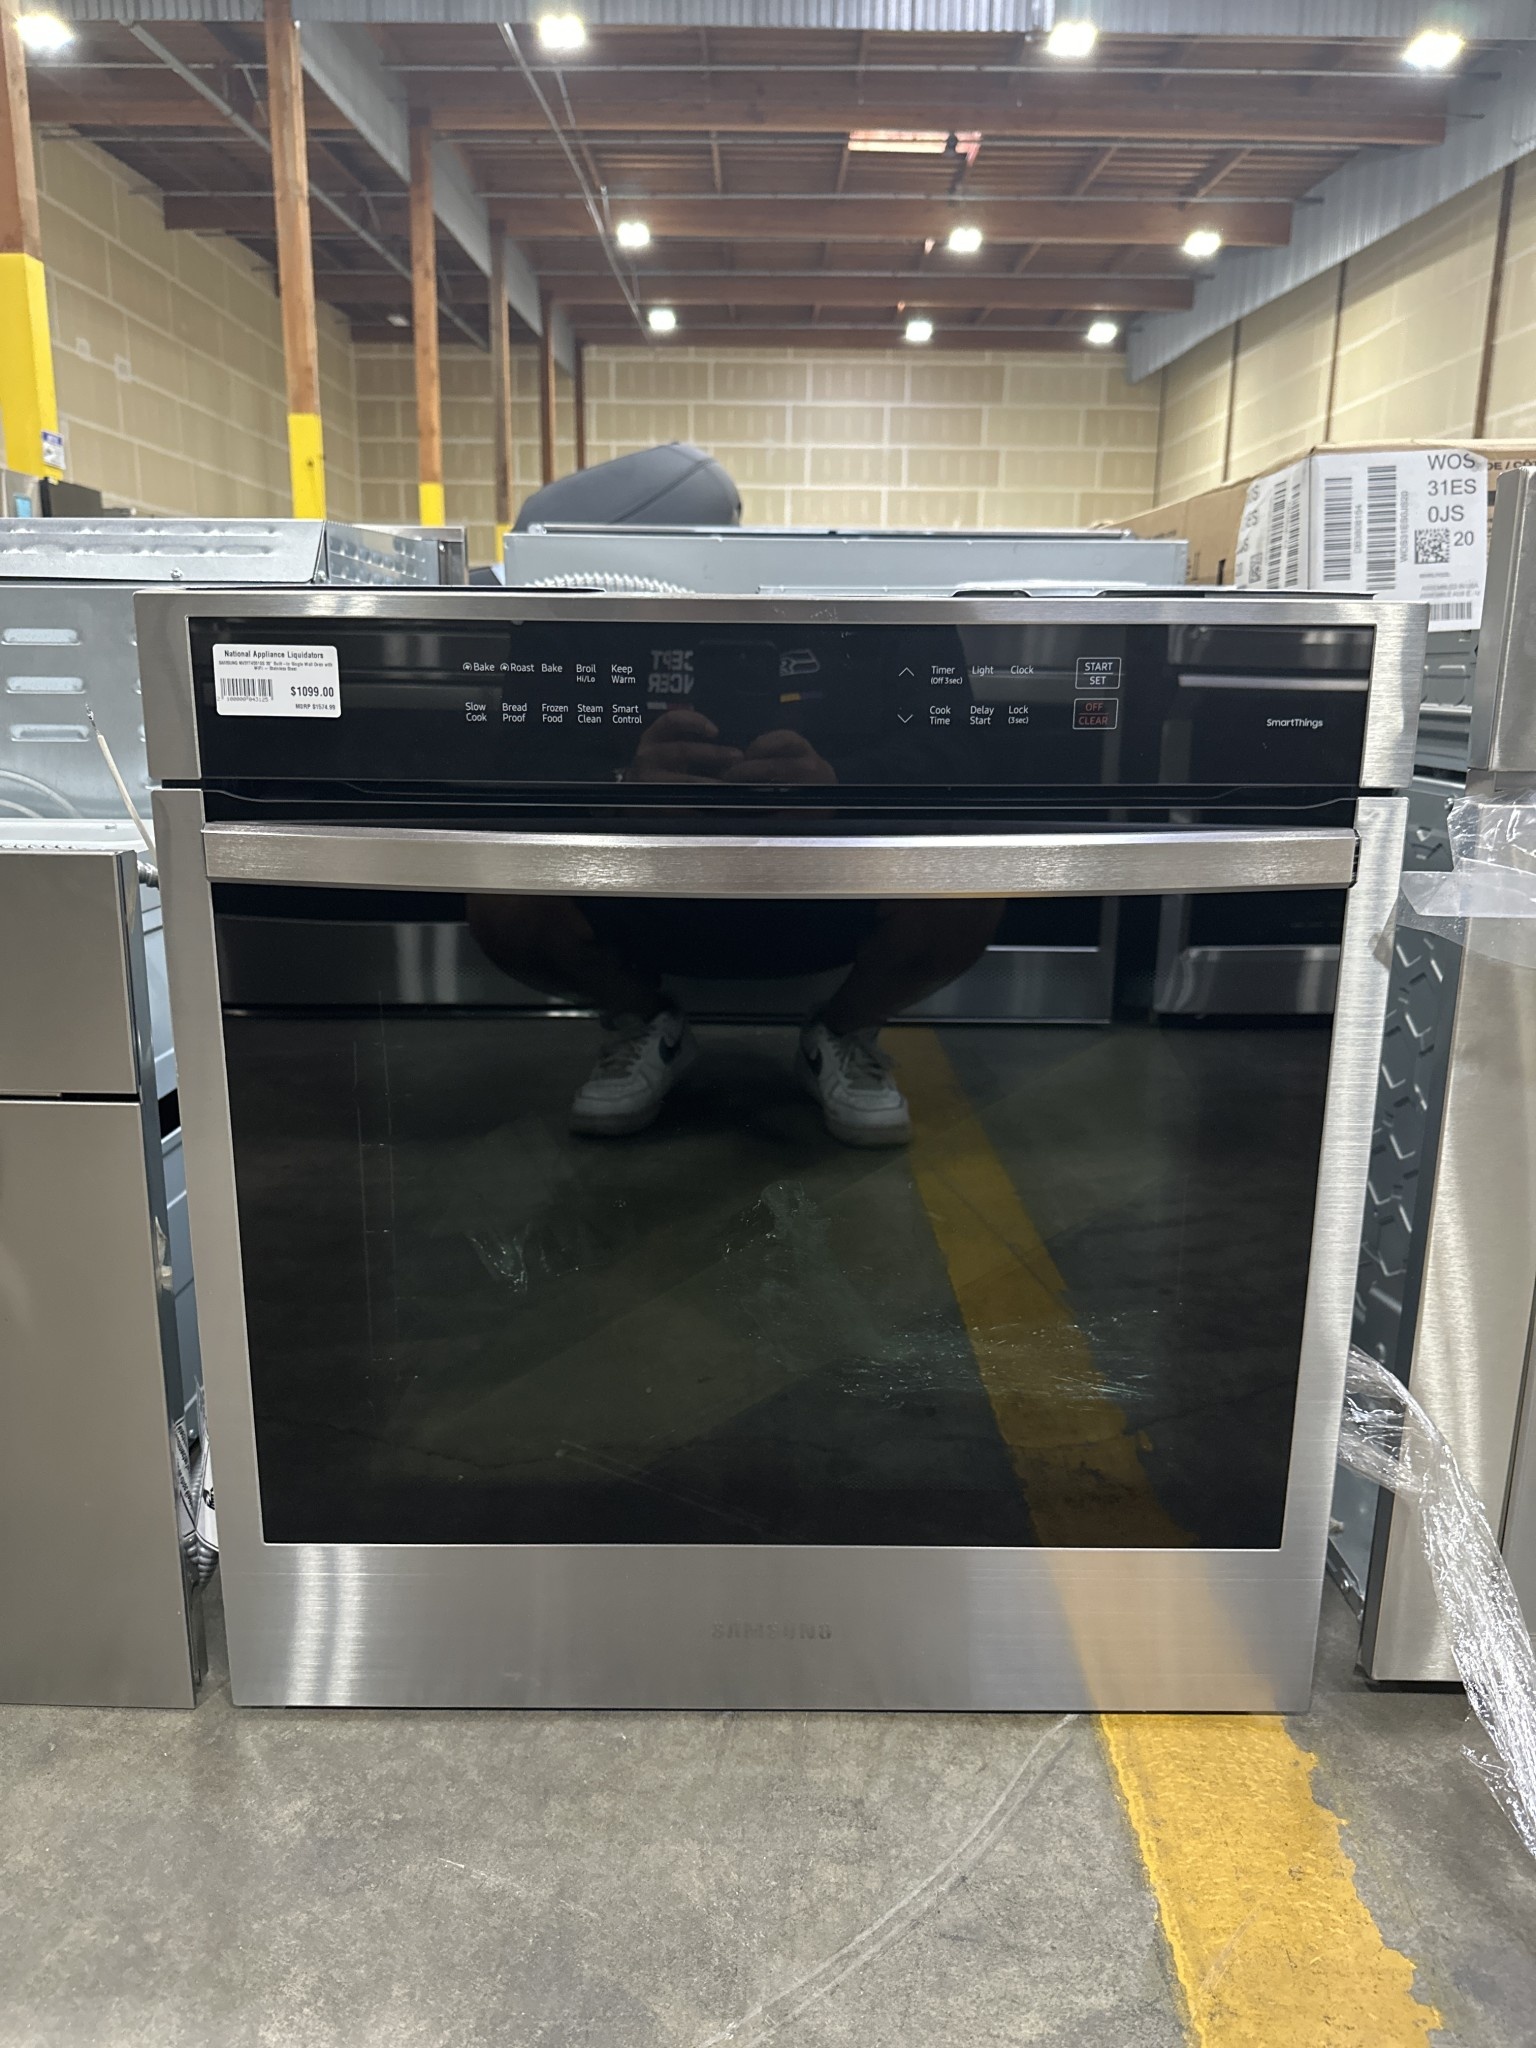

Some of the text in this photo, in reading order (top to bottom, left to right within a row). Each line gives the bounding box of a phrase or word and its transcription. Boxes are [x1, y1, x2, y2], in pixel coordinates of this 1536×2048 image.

[1427, 453, 1476, 470] WOS
[1428, 479, 1477, 495] 31ES
[1428, 505, 1464, 522] 0JS
[1454, 531, 1474, 546] 20
[224, 650, 324, 660] National Appliance Liquidators
[473, 663, 534, 672] Bake Roast
[541, 664, 563, 673] Bake
[576, 664, 596, 673] Broil
[611, 665, 633, 674] Keep
[931, 666, 955, 675] Timer
[972, 666, 994, 676] Light
[1010, 666, 1034, 675] Clock
[1084, 662, 1112, 671] START
[576, 675, 595, 683] Hi/Lo
[611, 676, 636, 684] Warm
[931, 677, 944, 685] (Off
[1089, 676, 1106, 685] SET
[290, 686, 334, 698] $1099.00
[465, 702, 486, 711] Slow
[502, 703, 527, 712] Bread
[542, 704, 569, 713] Frozen
[577, 704, 603, 713] Steam
[612, 705, 639, 713] Smart
[929, 705, 951, 715] Cook
[970, 705, 994, 716] Delay
[1009, 705, 1028, 714] Lock
[1085, 702, 1104, 712] OFF
[466, 713, 487, 722] Cook
[503, 713, 526, 722] Proof
[543, 714, 563, 723] Food
[578, 715, 601, 723] Clean
[612, 715, 642, 724] Control
[930, 716, 950, 725] Time
[970, 716, 991, 725] Start
[1078, 716, 1108, 725] CLEAR
[1266, 718, 1324, 729] SmartThings
